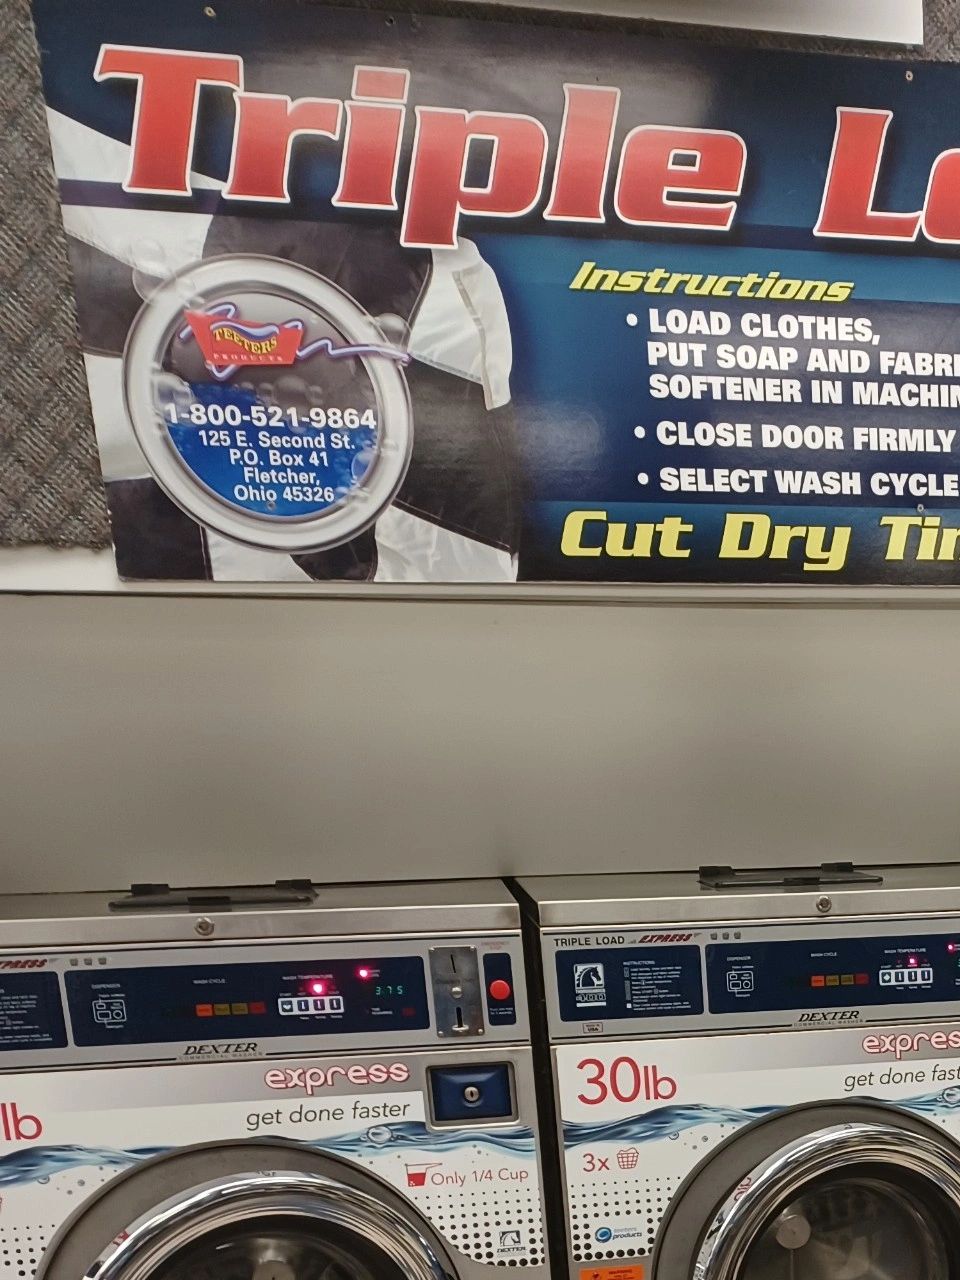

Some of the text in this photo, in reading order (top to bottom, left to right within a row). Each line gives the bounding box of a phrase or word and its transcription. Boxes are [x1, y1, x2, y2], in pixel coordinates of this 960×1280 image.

[94, 44, 747, 249] Triple
[569, 261, 854, 302] Instructions
[649, 308, 881, 345] LOAD CLOTHES,
[213, 327, 279, 355] TEETERS
[647, 341, 708, 368] PUT
[716, 344, 799, 371] SOAP
[807, 348, 870, 373] AND
[649, 374, 802, 403] SOFTENER
[811, 380, 842, 404] IN
[164, 403, 377, 429] 1-800-521-9864
[198, 430, 355, 449] 125 E. Second St.
[656, 420, 957, 453] CLOSE DOOR FIRMLY
[229, 449, 329, 467] P.O. Box 41
[243, 467, 320, 485] Fletcher,
[659, 467, 960, 497] SELECT WASH CYCLE
[233, 485, 335, 502] Ohio 45326
[559, 510, 693, 559] Cut
[718, 512, 853, 571] Dry
[553, 933, 693, 947] TRIPLE LOAD EXPRESS
[0, 958, 48, 970] PRESS
[798, 1010, 860, 1022] DEXTER
[183, 1042, 258, 1056] DEXTER
[264, 1062, 410, 1095] express
[576, 1056, 678, 1105] 30lb
[844, 1069, 874, 1092] get
[879, 1066, 926, 1086] done
[246, 1100, 411, 1131] get done faster
[583, 1153, 611, 1172] 3x
[431, 1168, 529, 1187] Only 1/4 Cup
